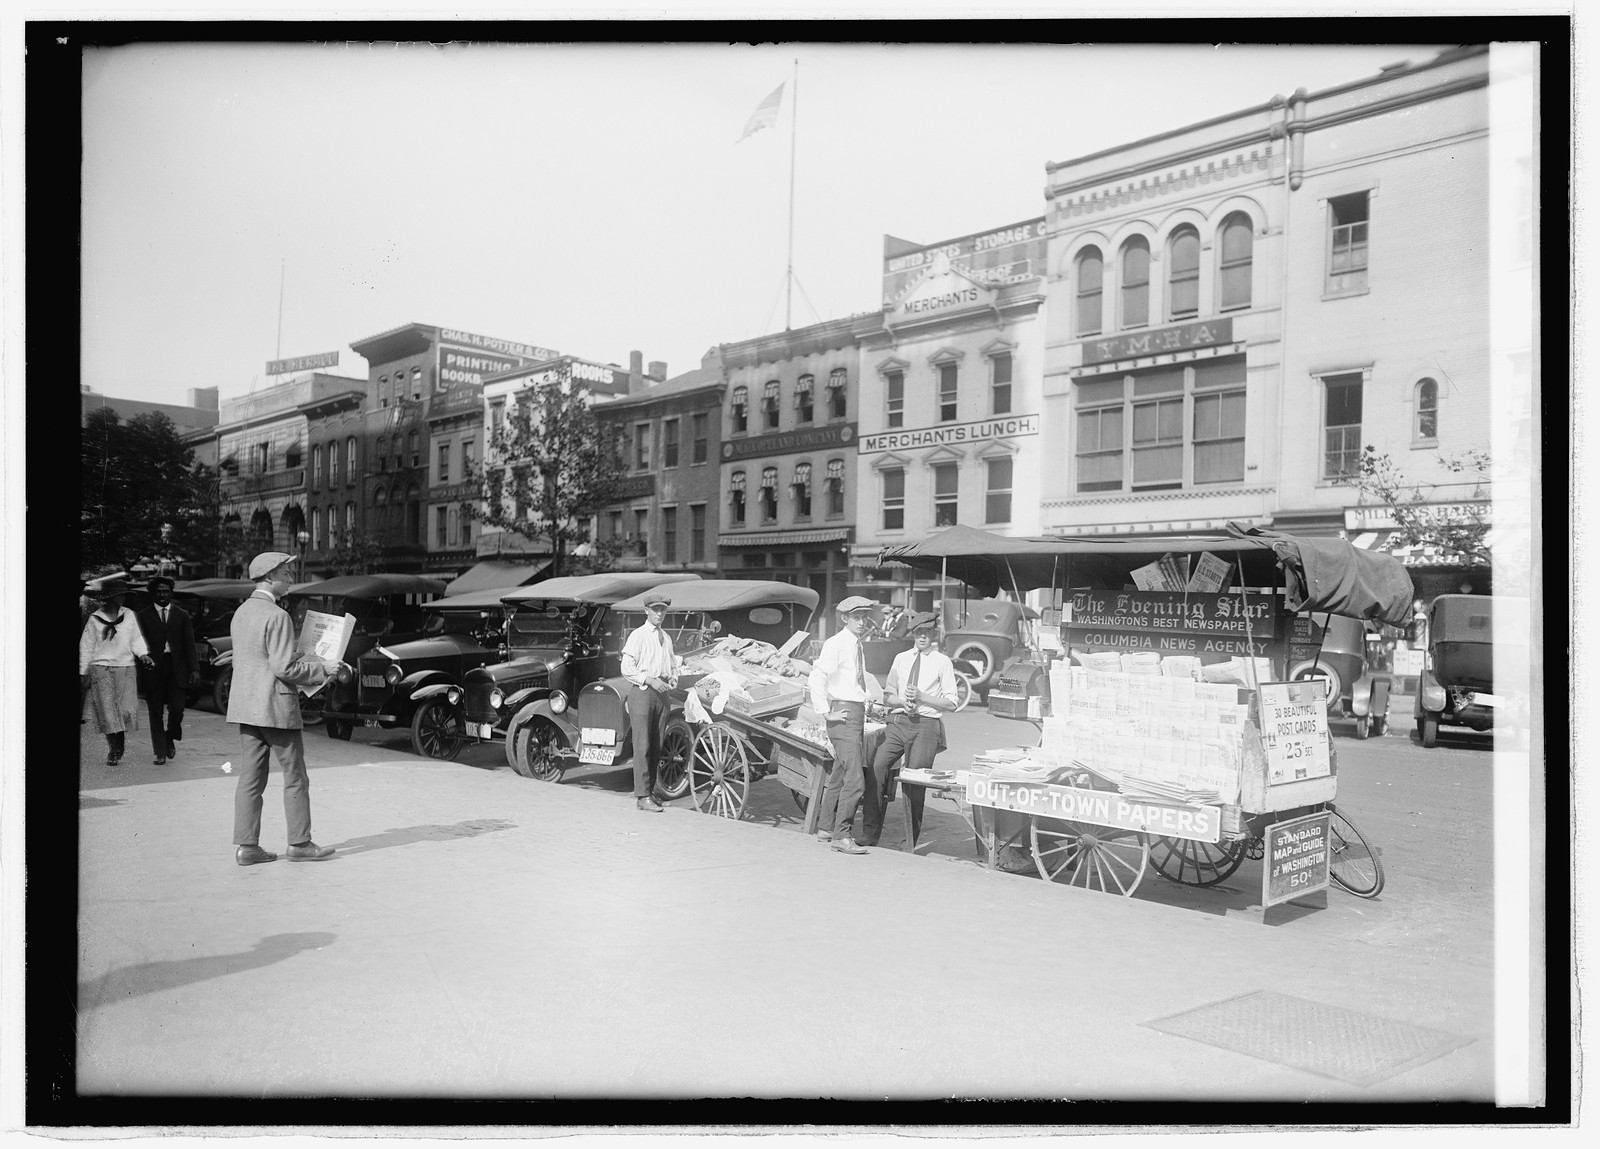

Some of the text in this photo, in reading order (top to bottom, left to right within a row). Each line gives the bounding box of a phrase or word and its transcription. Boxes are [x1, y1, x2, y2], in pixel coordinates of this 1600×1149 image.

[974, 225, 1032, 251] STORAGE
[904, 288, 978, 314] MERCHANTS
[571, 361, 614, 384] ROOMS
[866, 427, 966, 450] MERCHANTS
[1437, 504, 1492, 517] BARB
[1071, 593, 1105, 616] The
[1114, 594, 1206, 619] Evening
[1077, 614, 1254, 632] WASHINGTON'S BEST NEWSPAPER
[1085, 633, 1268, 655] COLUMBIA NEWS AGENCY
[1275, 705, 1317, 719] 30 BEAUTIFUL
[1278, 720, 1317, 736] POST CARDS
[974, 780, 1209, 834] OUT-OF-TOWN PAPERS
[1278, 826, 1321, 846] STANDARD
[1274, 837, 1324, 860] MAP and GUIDE
[1273, 850, 1326, 877] of WASHINGTON
